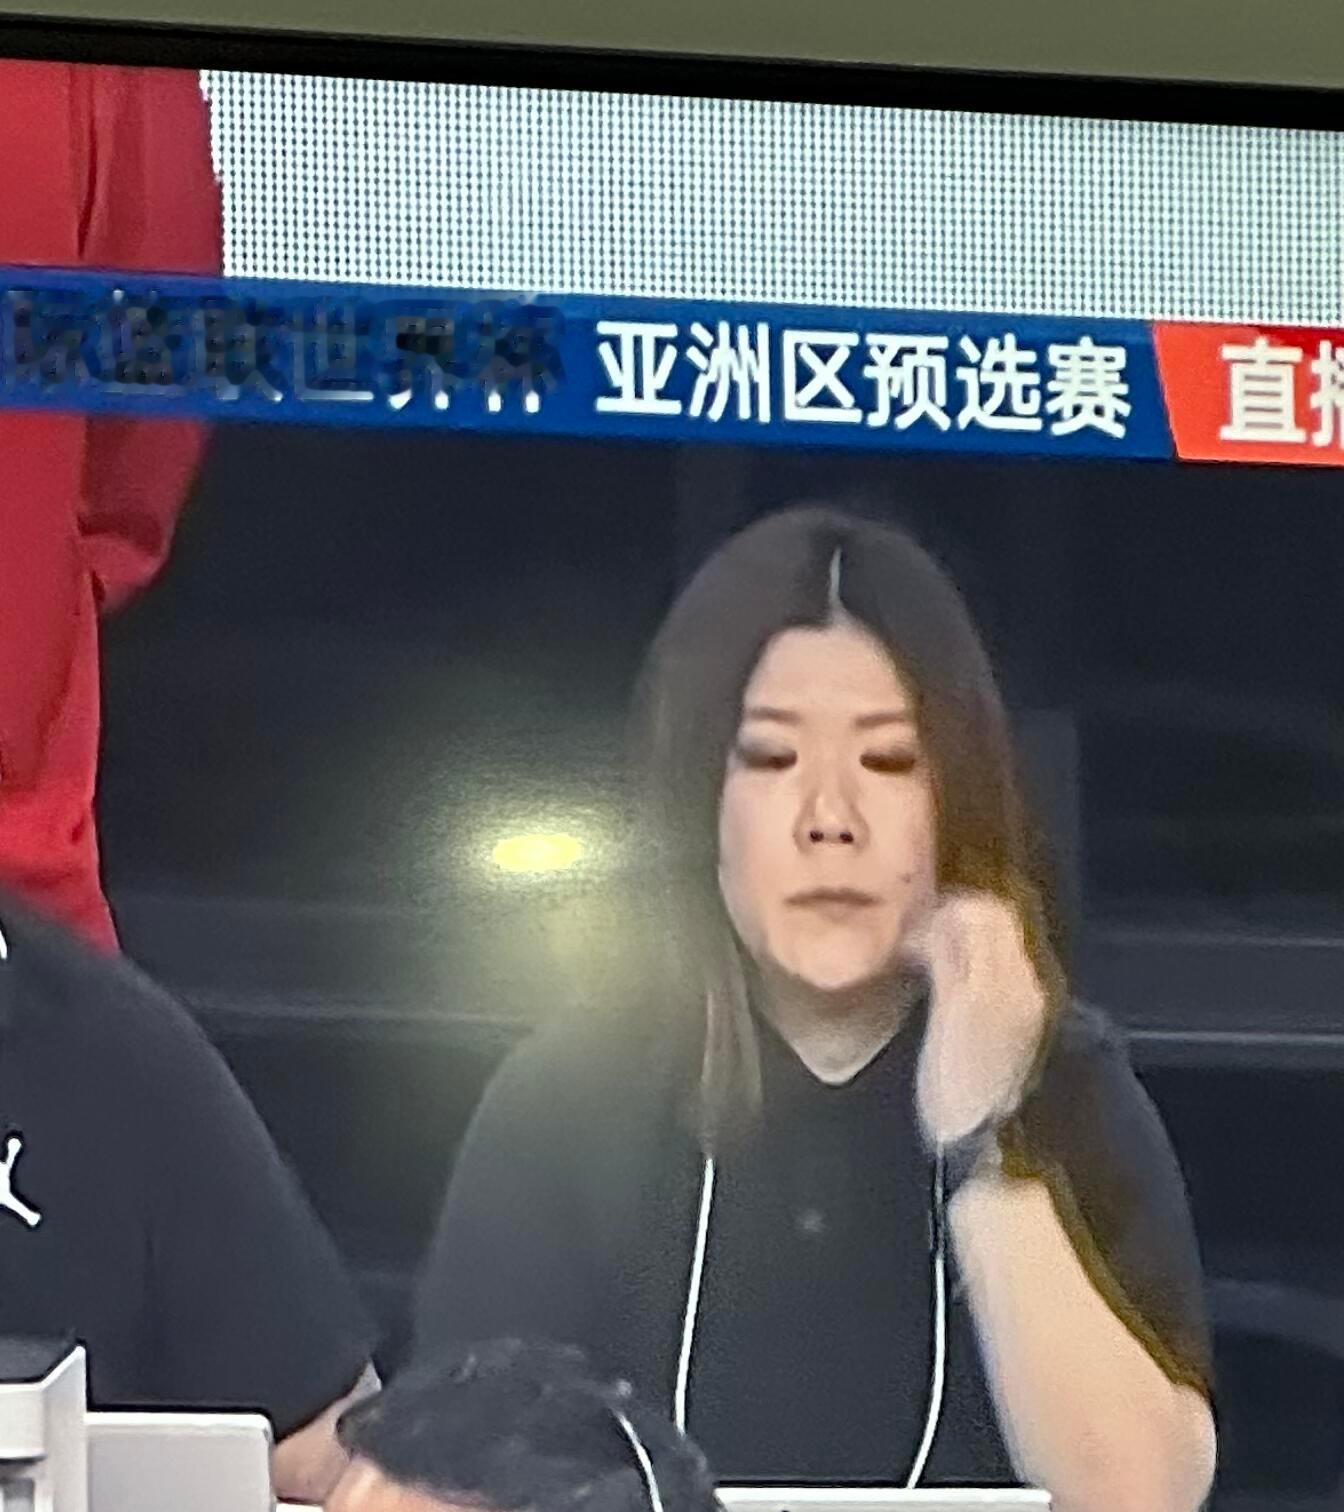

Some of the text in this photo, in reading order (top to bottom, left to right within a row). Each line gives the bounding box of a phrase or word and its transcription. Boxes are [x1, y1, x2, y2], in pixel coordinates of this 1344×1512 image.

[594, 319, 1134, 440] 亚洲区预选赛
